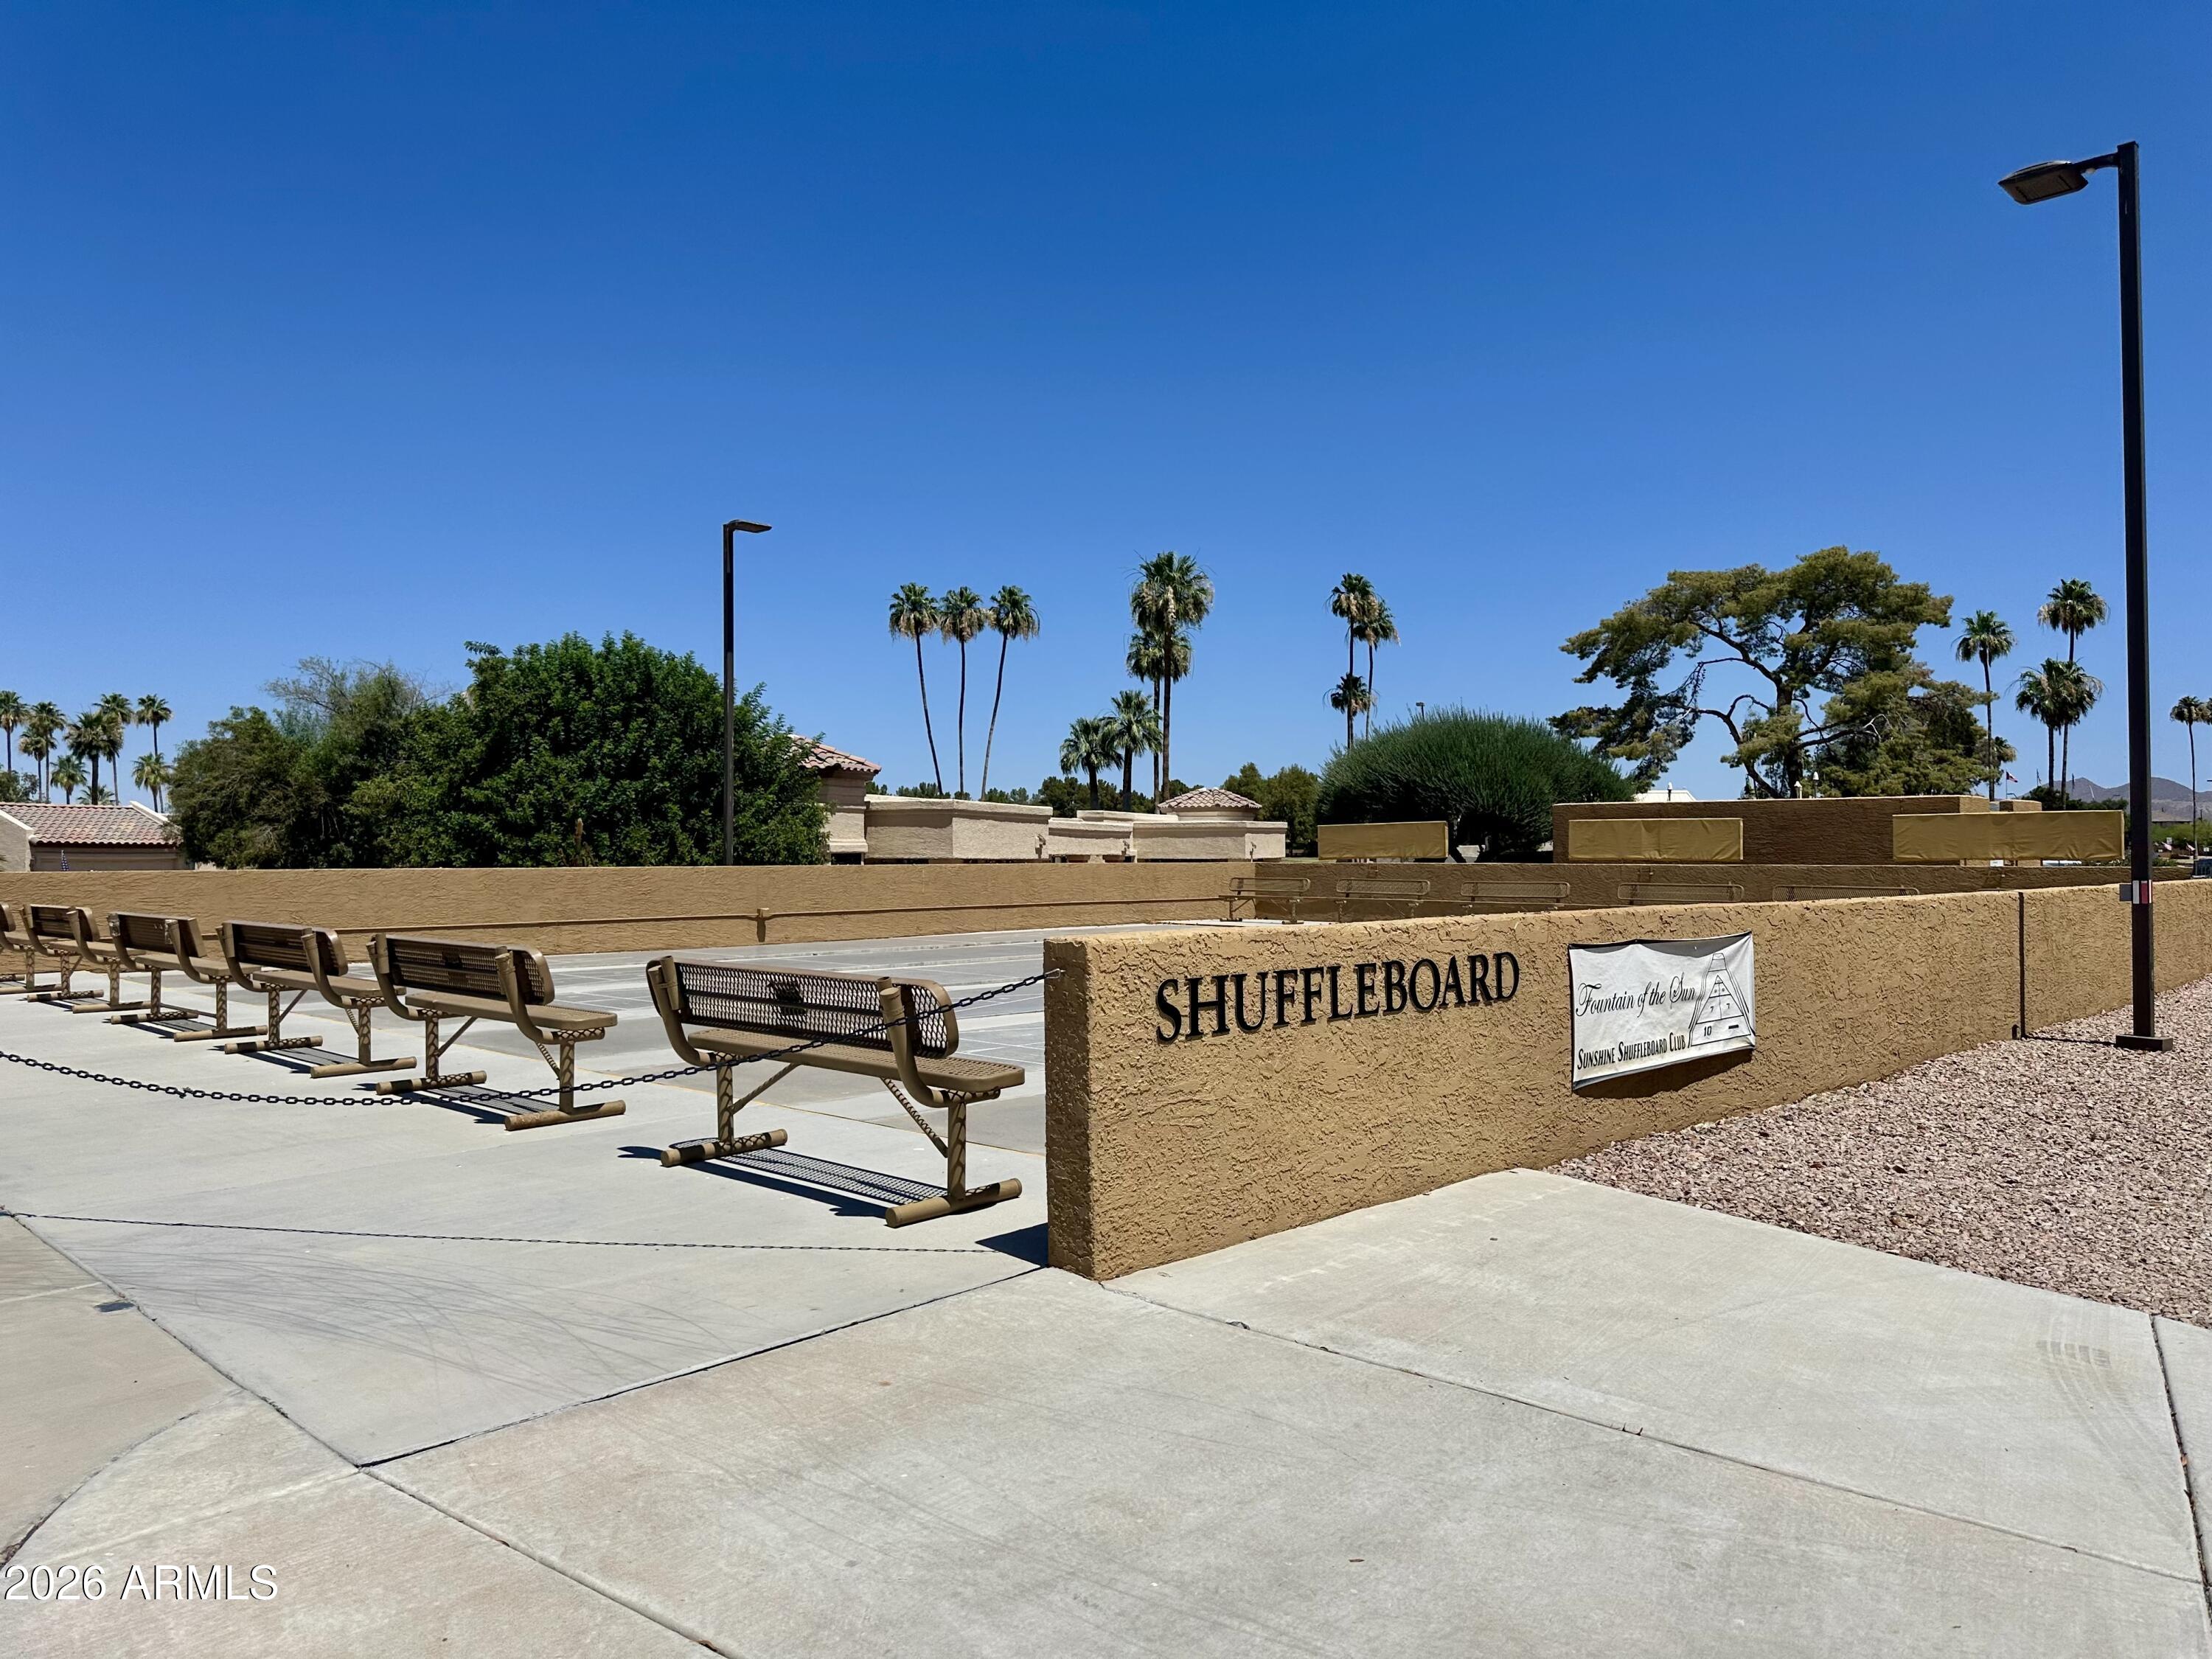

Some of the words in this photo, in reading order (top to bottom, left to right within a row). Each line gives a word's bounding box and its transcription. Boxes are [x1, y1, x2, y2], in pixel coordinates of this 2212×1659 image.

[1155, 951, 1520, 1043] SHUFFLEBOARD
[1576, 983, 1634, 1017] Fountain
[1637, 981, 1652, 1018] of
[1649, 981, 1666, 1005] the
[1669, 972, 1697, 1009] Sun
[1577, 1046, 1615, 1070] SUNSHINE
[1618, 1041, 1667, 1062] SHUFFLEBOARD
[1669, 1032, 1686, 1051] CLUB
[1704, 1026, 1712, 1037] 10
